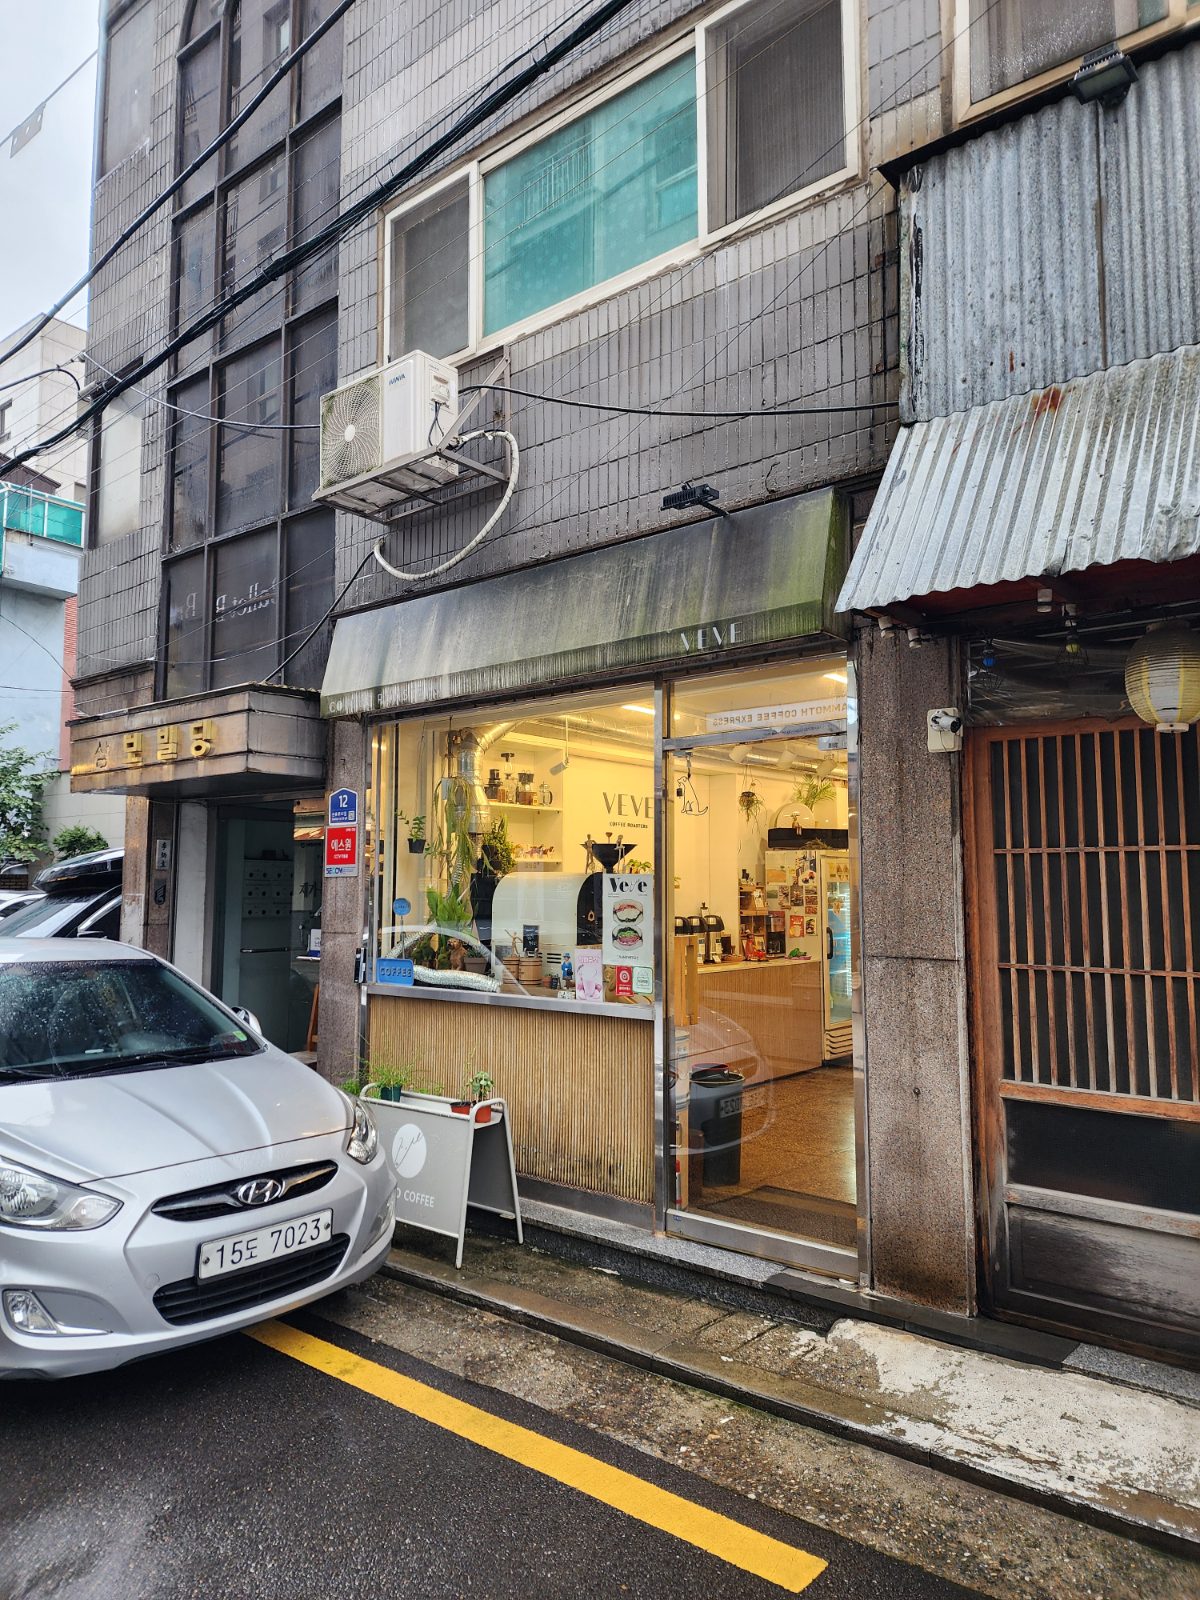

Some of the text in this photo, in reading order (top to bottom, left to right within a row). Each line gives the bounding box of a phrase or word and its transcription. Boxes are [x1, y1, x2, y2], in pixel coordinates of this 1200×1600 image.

[680, 621, 744, 651] VEVE
[338, 794, 348, 808] 12
[602, 791, 654, 819] VEVE
[330, 838, 352, 852] 에스원
[380, 967, 412, 978] COFFEE
[403, 1189, 436, 1208] COFFEE
[216, 1217, 321, 1269] 15도 7023
